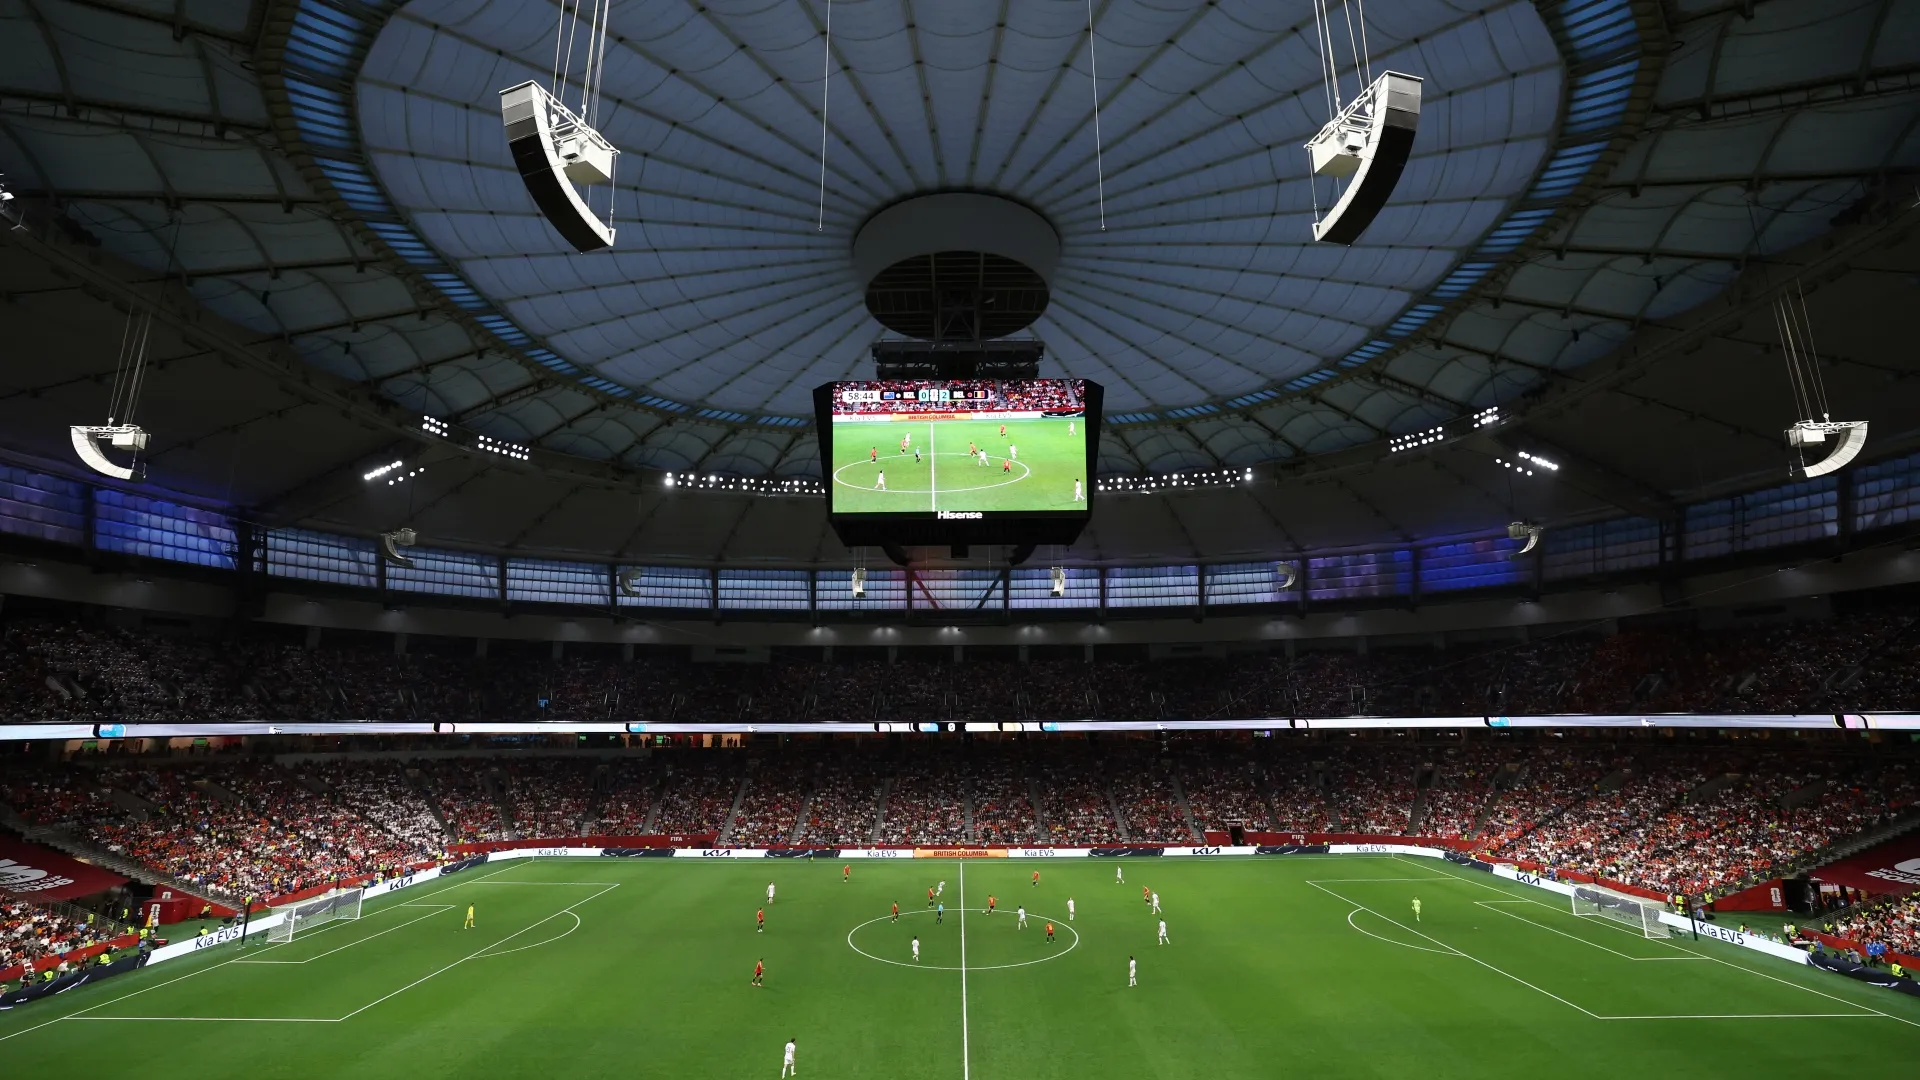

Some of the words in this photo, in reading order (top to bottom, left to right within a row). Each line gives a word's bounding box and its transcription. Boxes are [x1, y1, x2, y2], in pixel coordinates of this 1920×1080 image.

[848, 392, 874, 400] 58:44
[937, 510, 983, 519] Hisense
[1024, 849, 1037, 857] Kia
[1039, 849, 1055, 857] EV5
[195, 935, 214, 949] Kia
[216, 926, 239, 943] EV5
[1698, 922, 1718, 938] Kia
[1719, 929, 1744, 945] EV5
